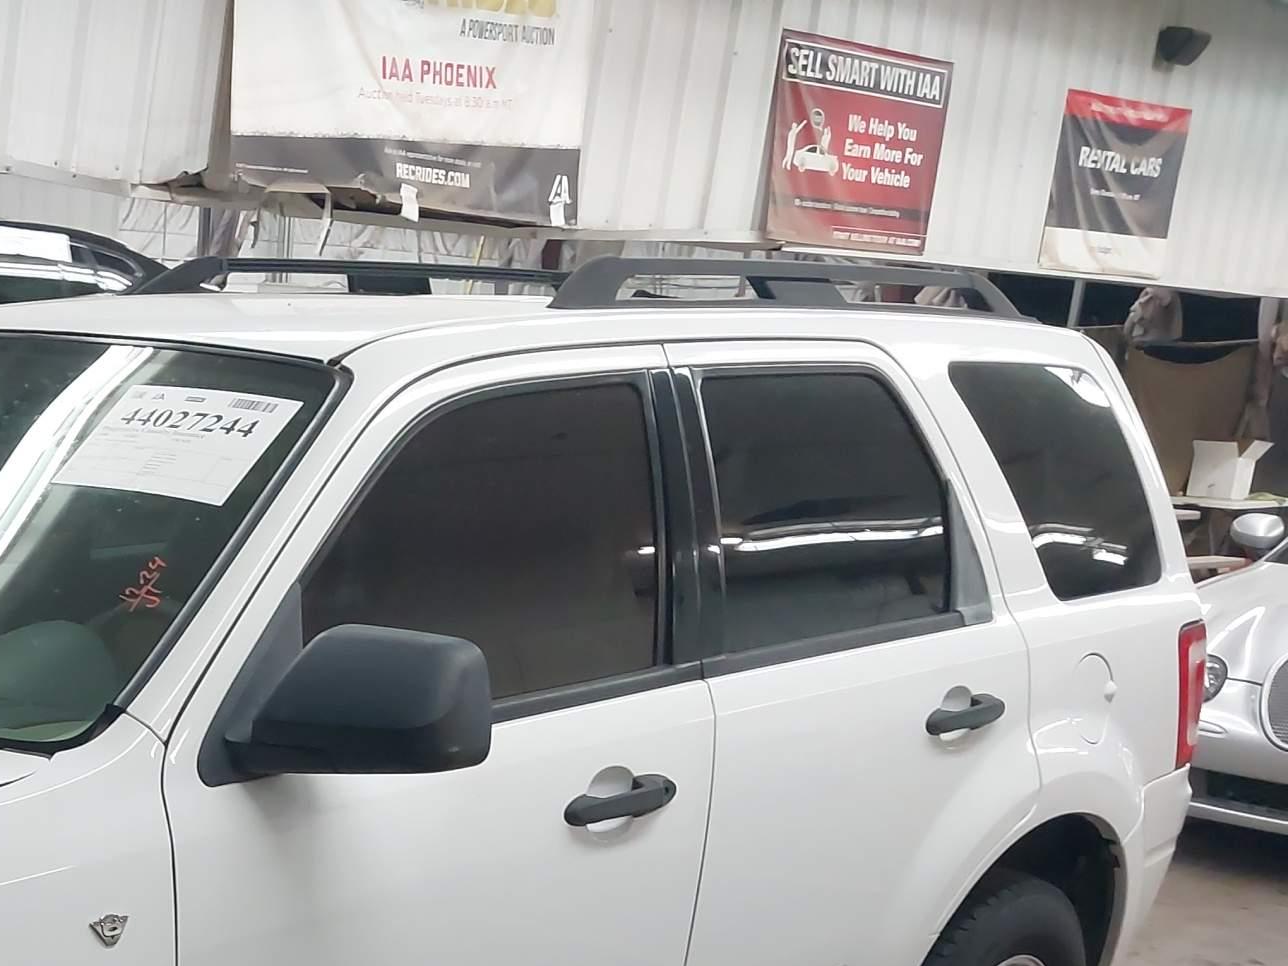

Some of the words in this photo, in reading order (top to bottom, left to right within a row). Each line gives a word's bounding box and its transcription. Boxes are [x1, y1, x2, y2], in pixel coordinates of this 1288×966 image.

[467, 19, 519, 43] POWERSPORT
[520, 24, 556, 46] AUCTION
[381, 55, 414, 83] IAA
[420, 60, 497, 90] PHOENIX
[787, 47, 823, 80] SELL
[826, 54, 879, 89] SMART
[880, 64, 917, 96] WITH
[916, 72, 941, 101] IAA
[848, 113, 866, 134] We
[868, 118, 895, 142] Help
[897, 121, 918, 142] You
[843, 138, 872, 160] Earn
[872, 142, 903, 165] More
[904, 148, 924, 168] For
[1078, 146, 1128, 175] RENTAL
[1129, 157, 1163, 178] CARS
[395, 162, 471, 188] RECRIDES.COM
[842, 162, 868, 183] Your
[870, 167, 911, 189] Vehicle
[120, 406, 262, 438] 44027244
